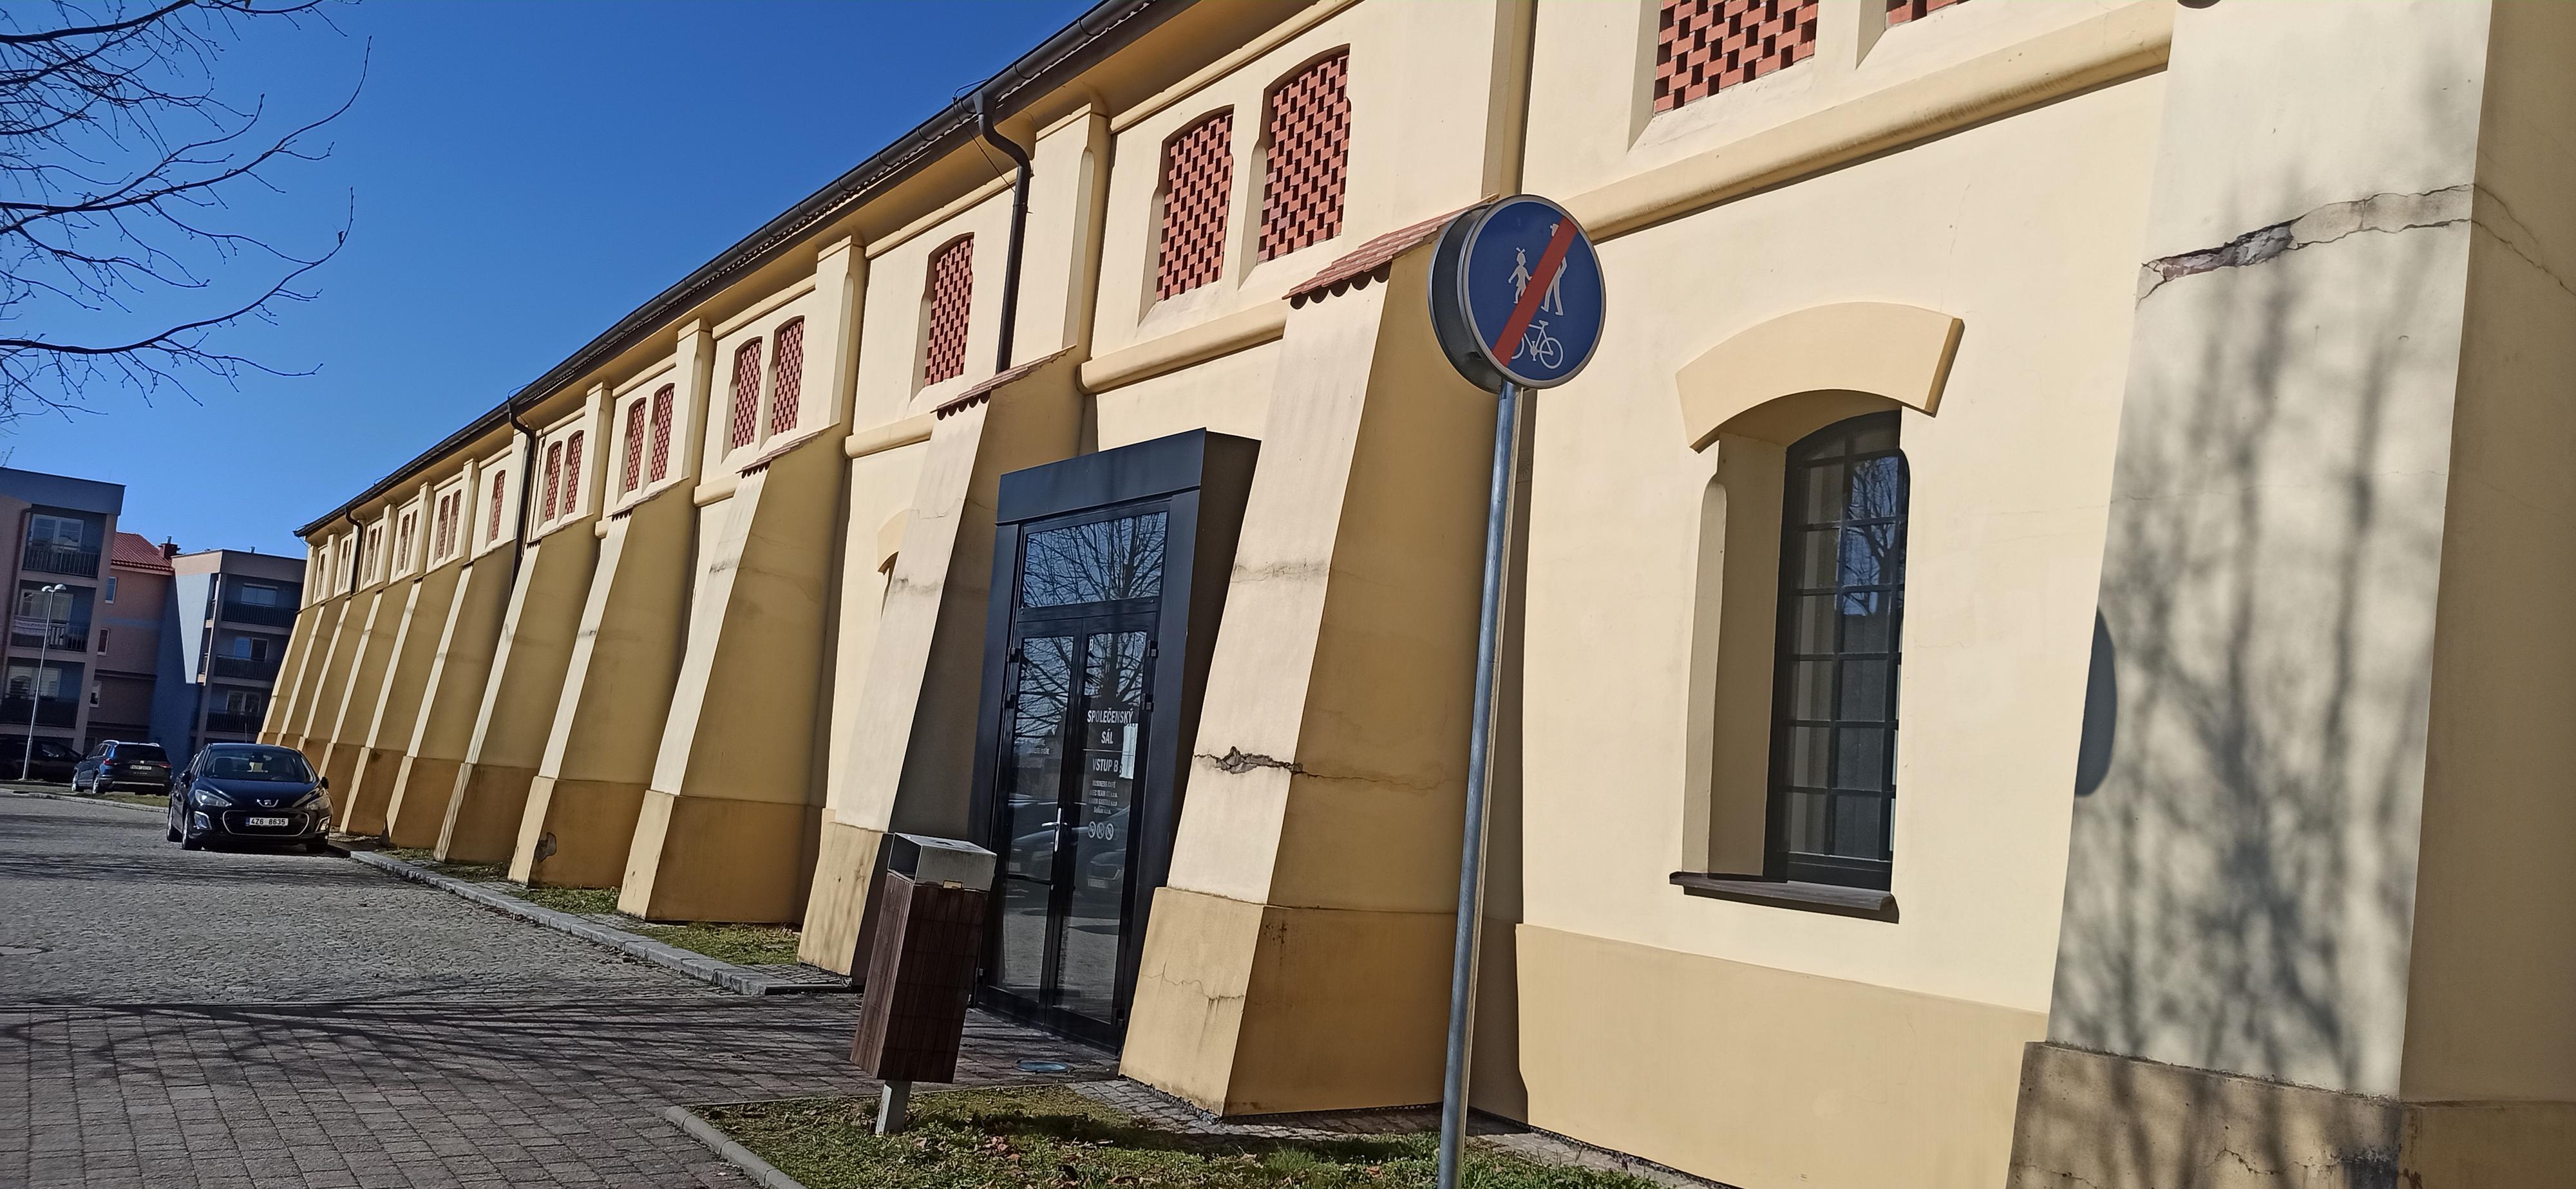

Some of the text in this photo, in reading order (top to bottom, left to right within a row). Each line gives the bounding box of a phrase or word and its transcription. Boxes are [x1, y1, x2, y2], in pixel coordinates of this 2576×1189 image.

[1087, 707, 1133, 724] SPOLEČENSKÝ
[1101, 728, 1113, 744] SÁL
[1092, 758, 1119, 772] VSTUP B
